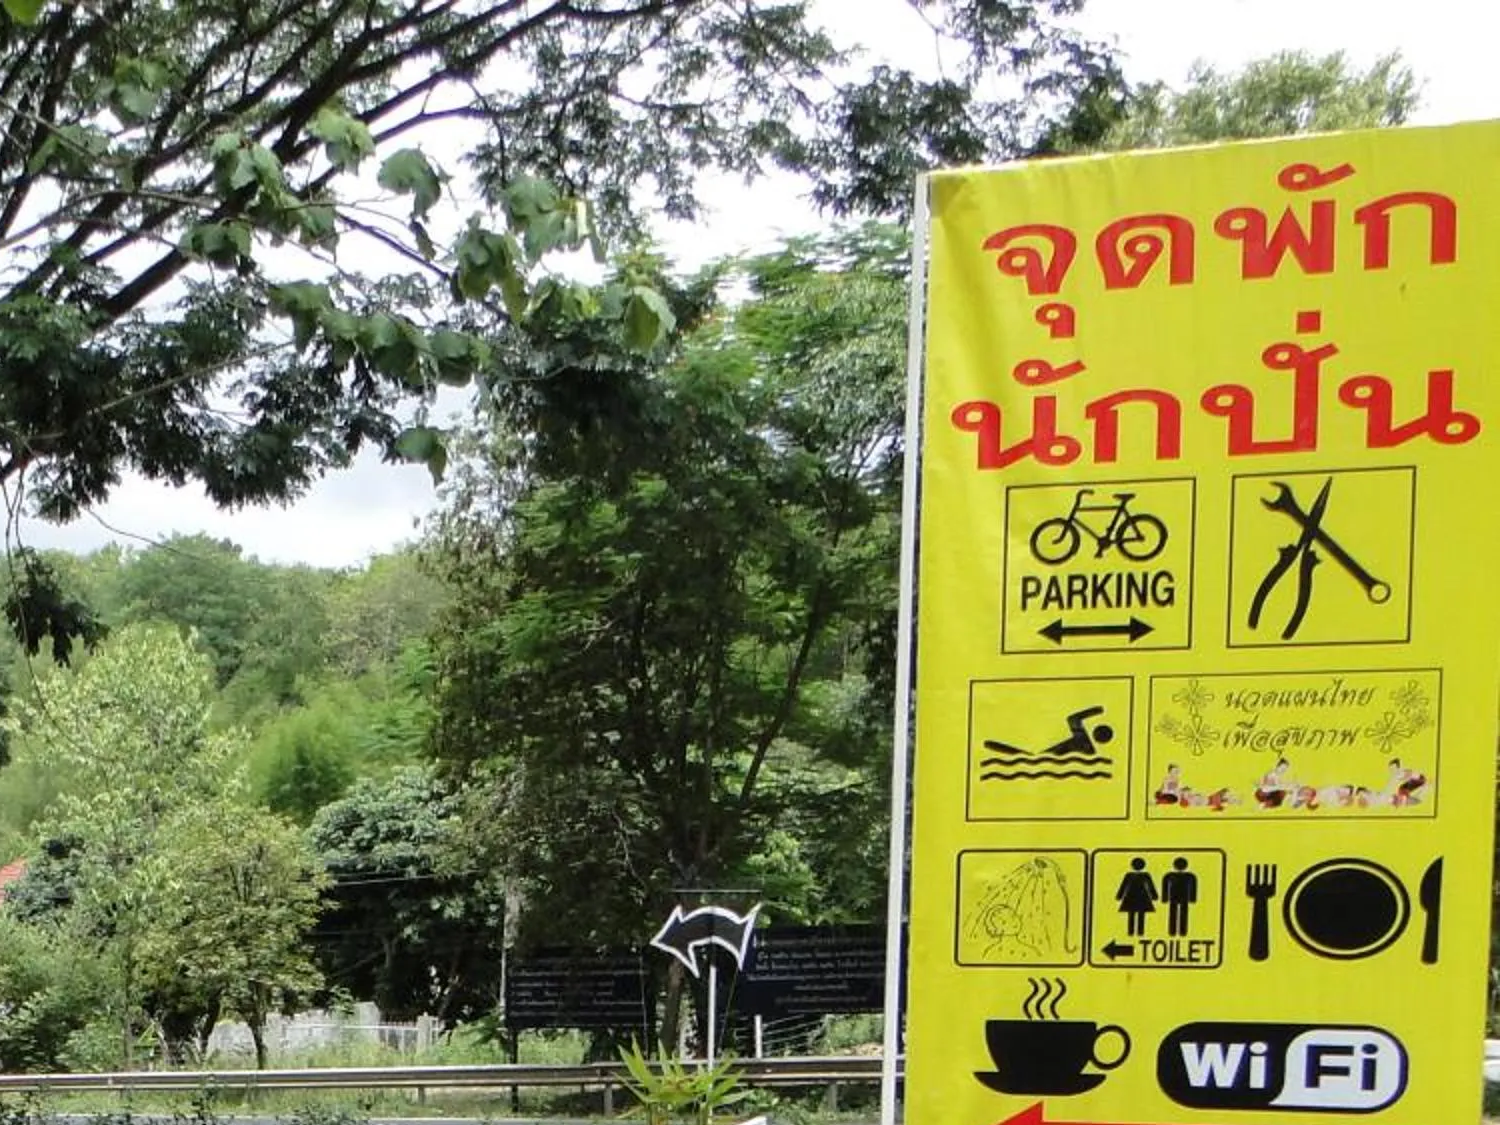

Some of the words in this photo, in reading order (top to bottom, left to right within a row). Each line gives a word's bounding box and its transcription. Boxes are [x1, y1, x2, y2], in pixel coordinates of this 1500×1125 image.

[984, 162, 1457, 339] จุดพัก
[951, 310, 1482, 470] นักปั่น
[1020, 571, 1176, 612] PARKING
[1223, 679, 1376, 712] นวดแผนไทย
[1138, 939, 1215, 963] TOILET
